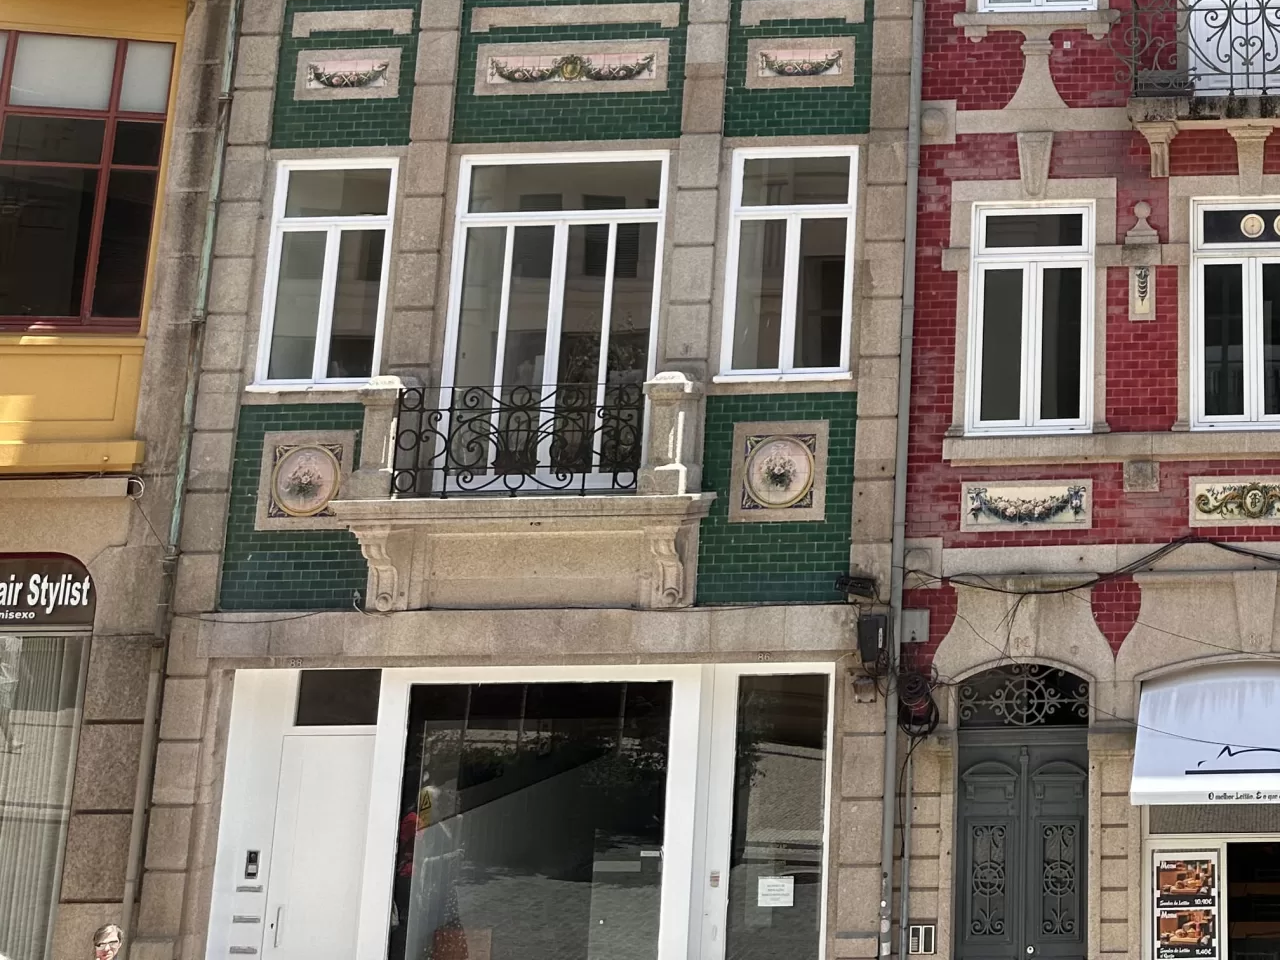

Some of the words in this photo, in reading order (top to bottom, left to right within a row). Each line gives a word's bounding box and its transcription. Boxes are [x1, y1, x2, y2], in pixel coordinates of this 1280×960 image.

[27, 573, 90, 614] Stylist
[757, 652, 771, 661] 86
[290, 658, 303, 668] 88
